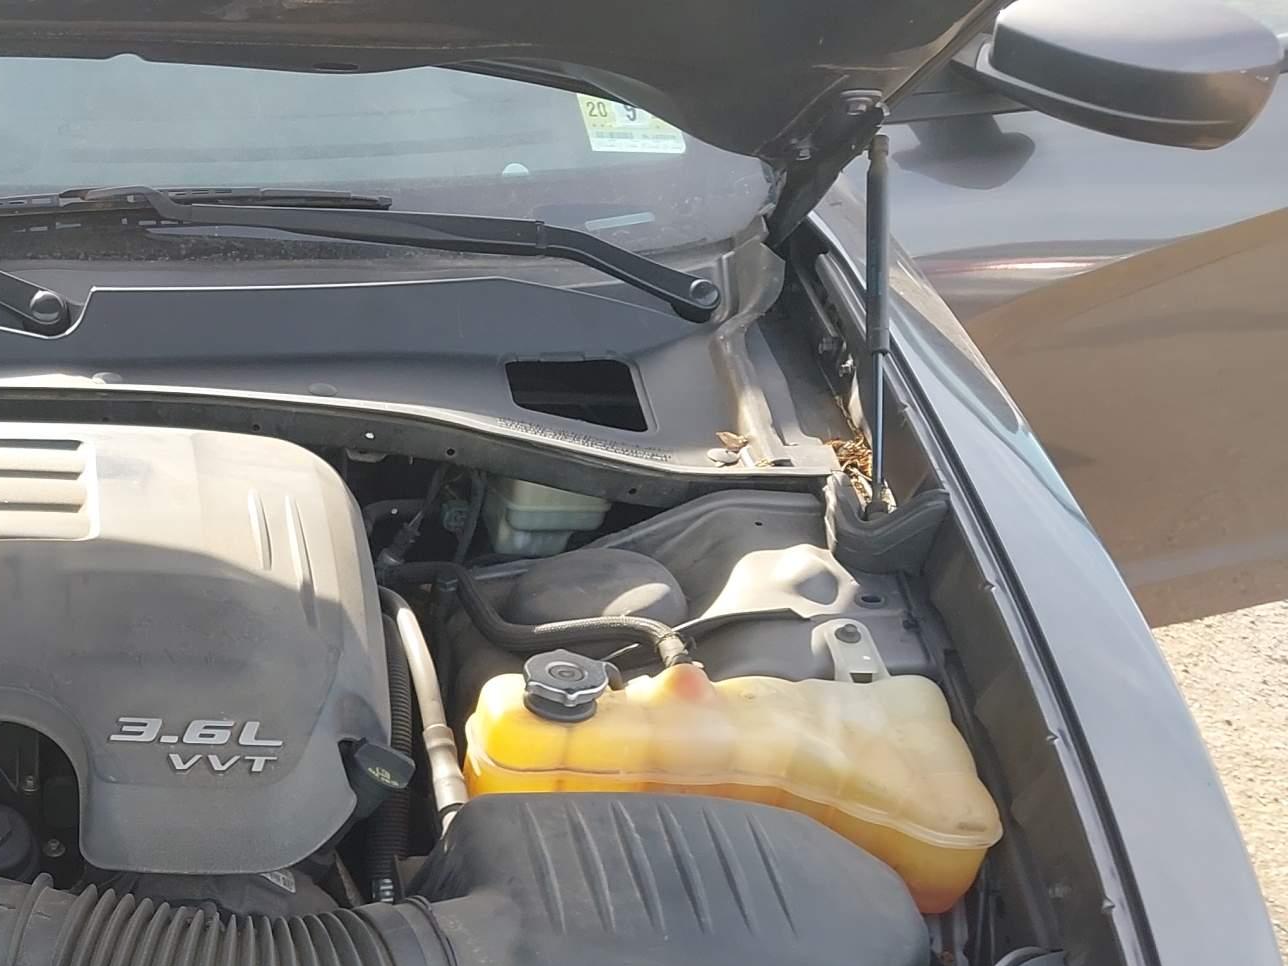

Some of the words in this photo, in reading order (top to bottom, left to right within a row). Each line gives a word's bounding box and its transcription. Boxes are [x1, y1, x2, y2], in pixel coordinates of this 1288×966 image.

[586, 101, 607, 118] 20
[109, 716, 283, 747] 3.6L
[167, 753, 278, 772] VVT
